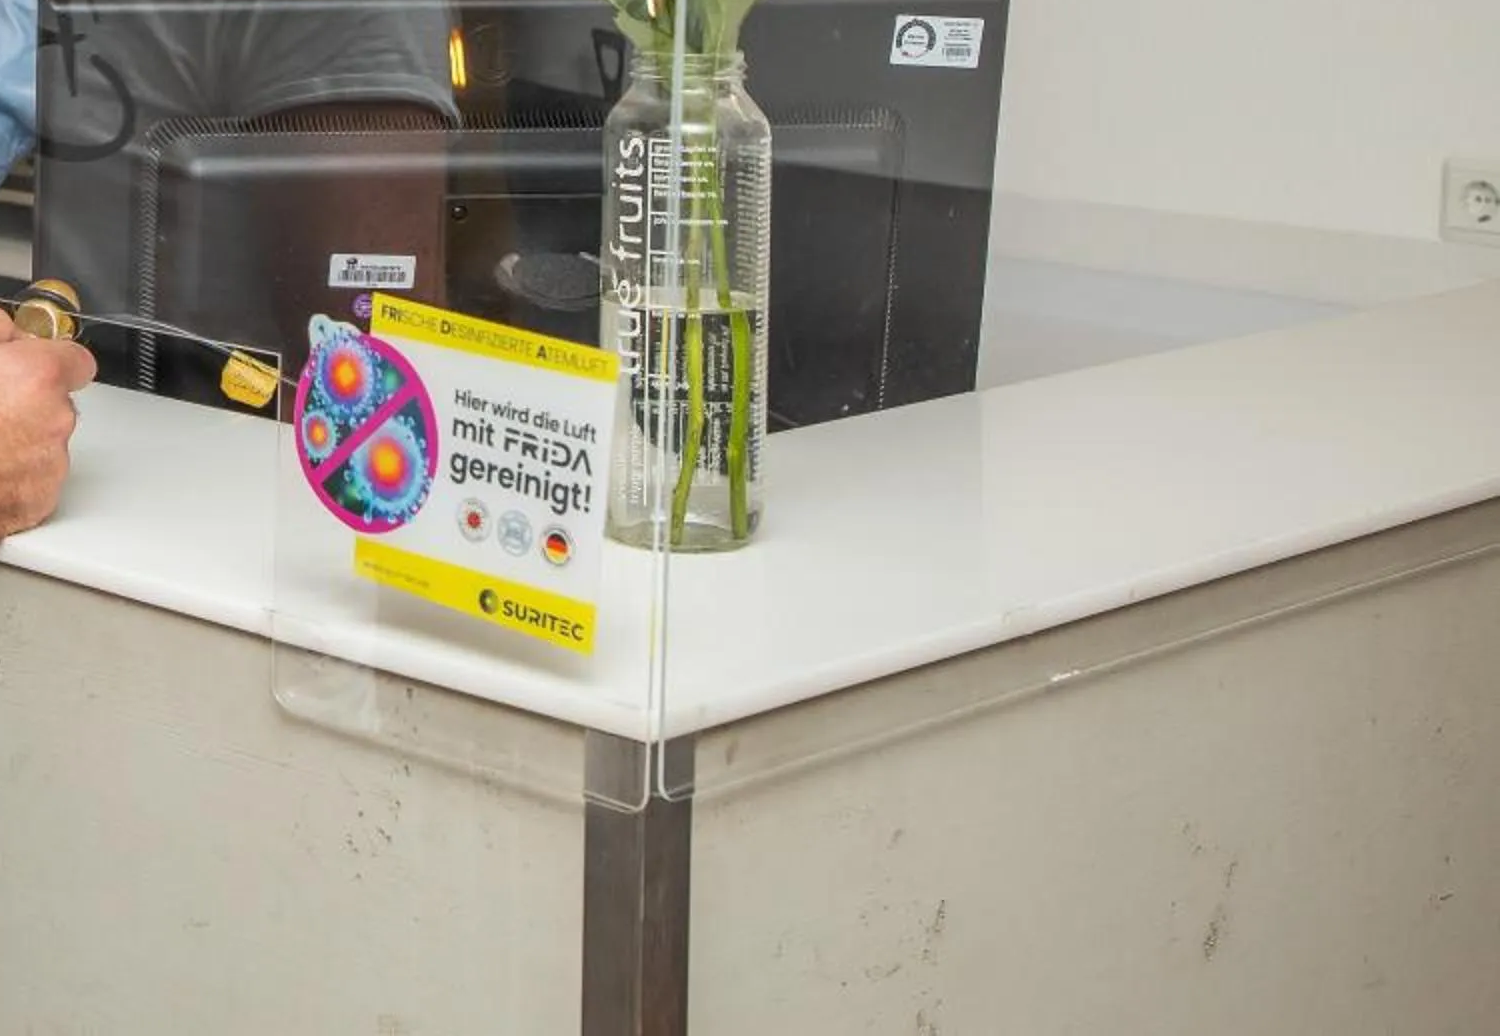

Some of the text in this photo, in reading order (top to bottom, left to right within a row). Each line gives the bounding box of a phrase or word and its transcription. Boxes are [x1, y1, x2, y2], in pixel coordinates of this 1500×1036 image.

[609, 135, 645, 261] fruits
[381, 303, 439, 333] FRISCHE
[536, 345, 609, 372] ATEMLUFT
[452, 417, 495, 448] mit
[454, 388, 597, 444] Hier wird die Luft
[450, 451, 592, 516] gereinigt!
[502, 599, 585, 642] SURITEC
